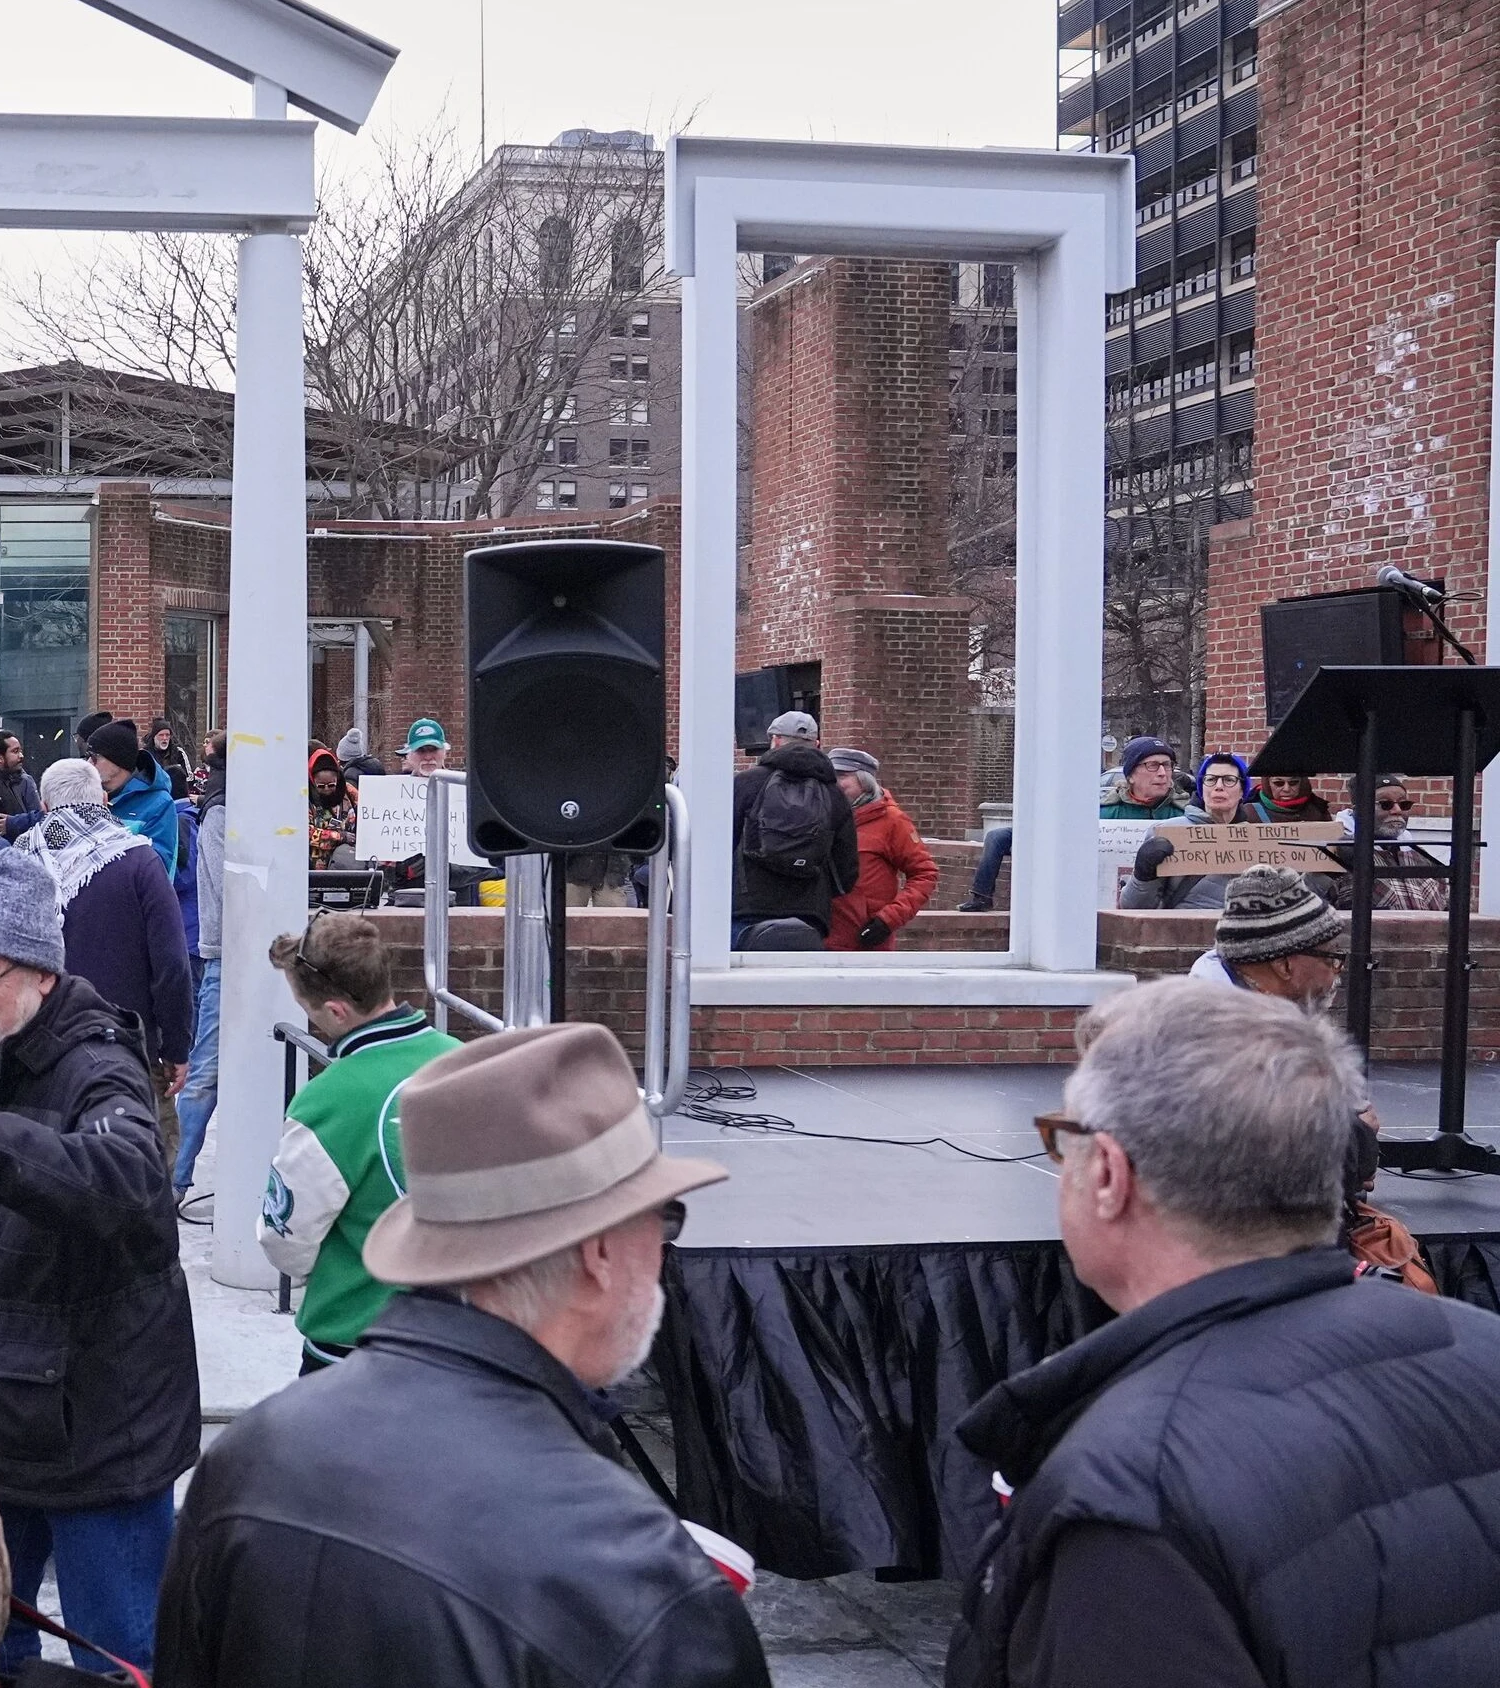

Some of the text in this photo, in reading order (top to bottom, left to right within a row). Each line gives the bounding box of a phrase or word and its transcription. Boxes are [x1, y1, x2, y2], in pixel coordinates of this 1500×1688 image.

[380, 826, 457, 838] AMERN
[1187, 826, 1299, 840] TELL THE TRUTH
[390, 840, 458, 856] HISTY
[1215, 850, 1236, 865] HAS
[1239, 849, 1253, 862] ITS
[1258, 850, 1286, 864] EYES
[1291, 850, 1306, 862] ON
